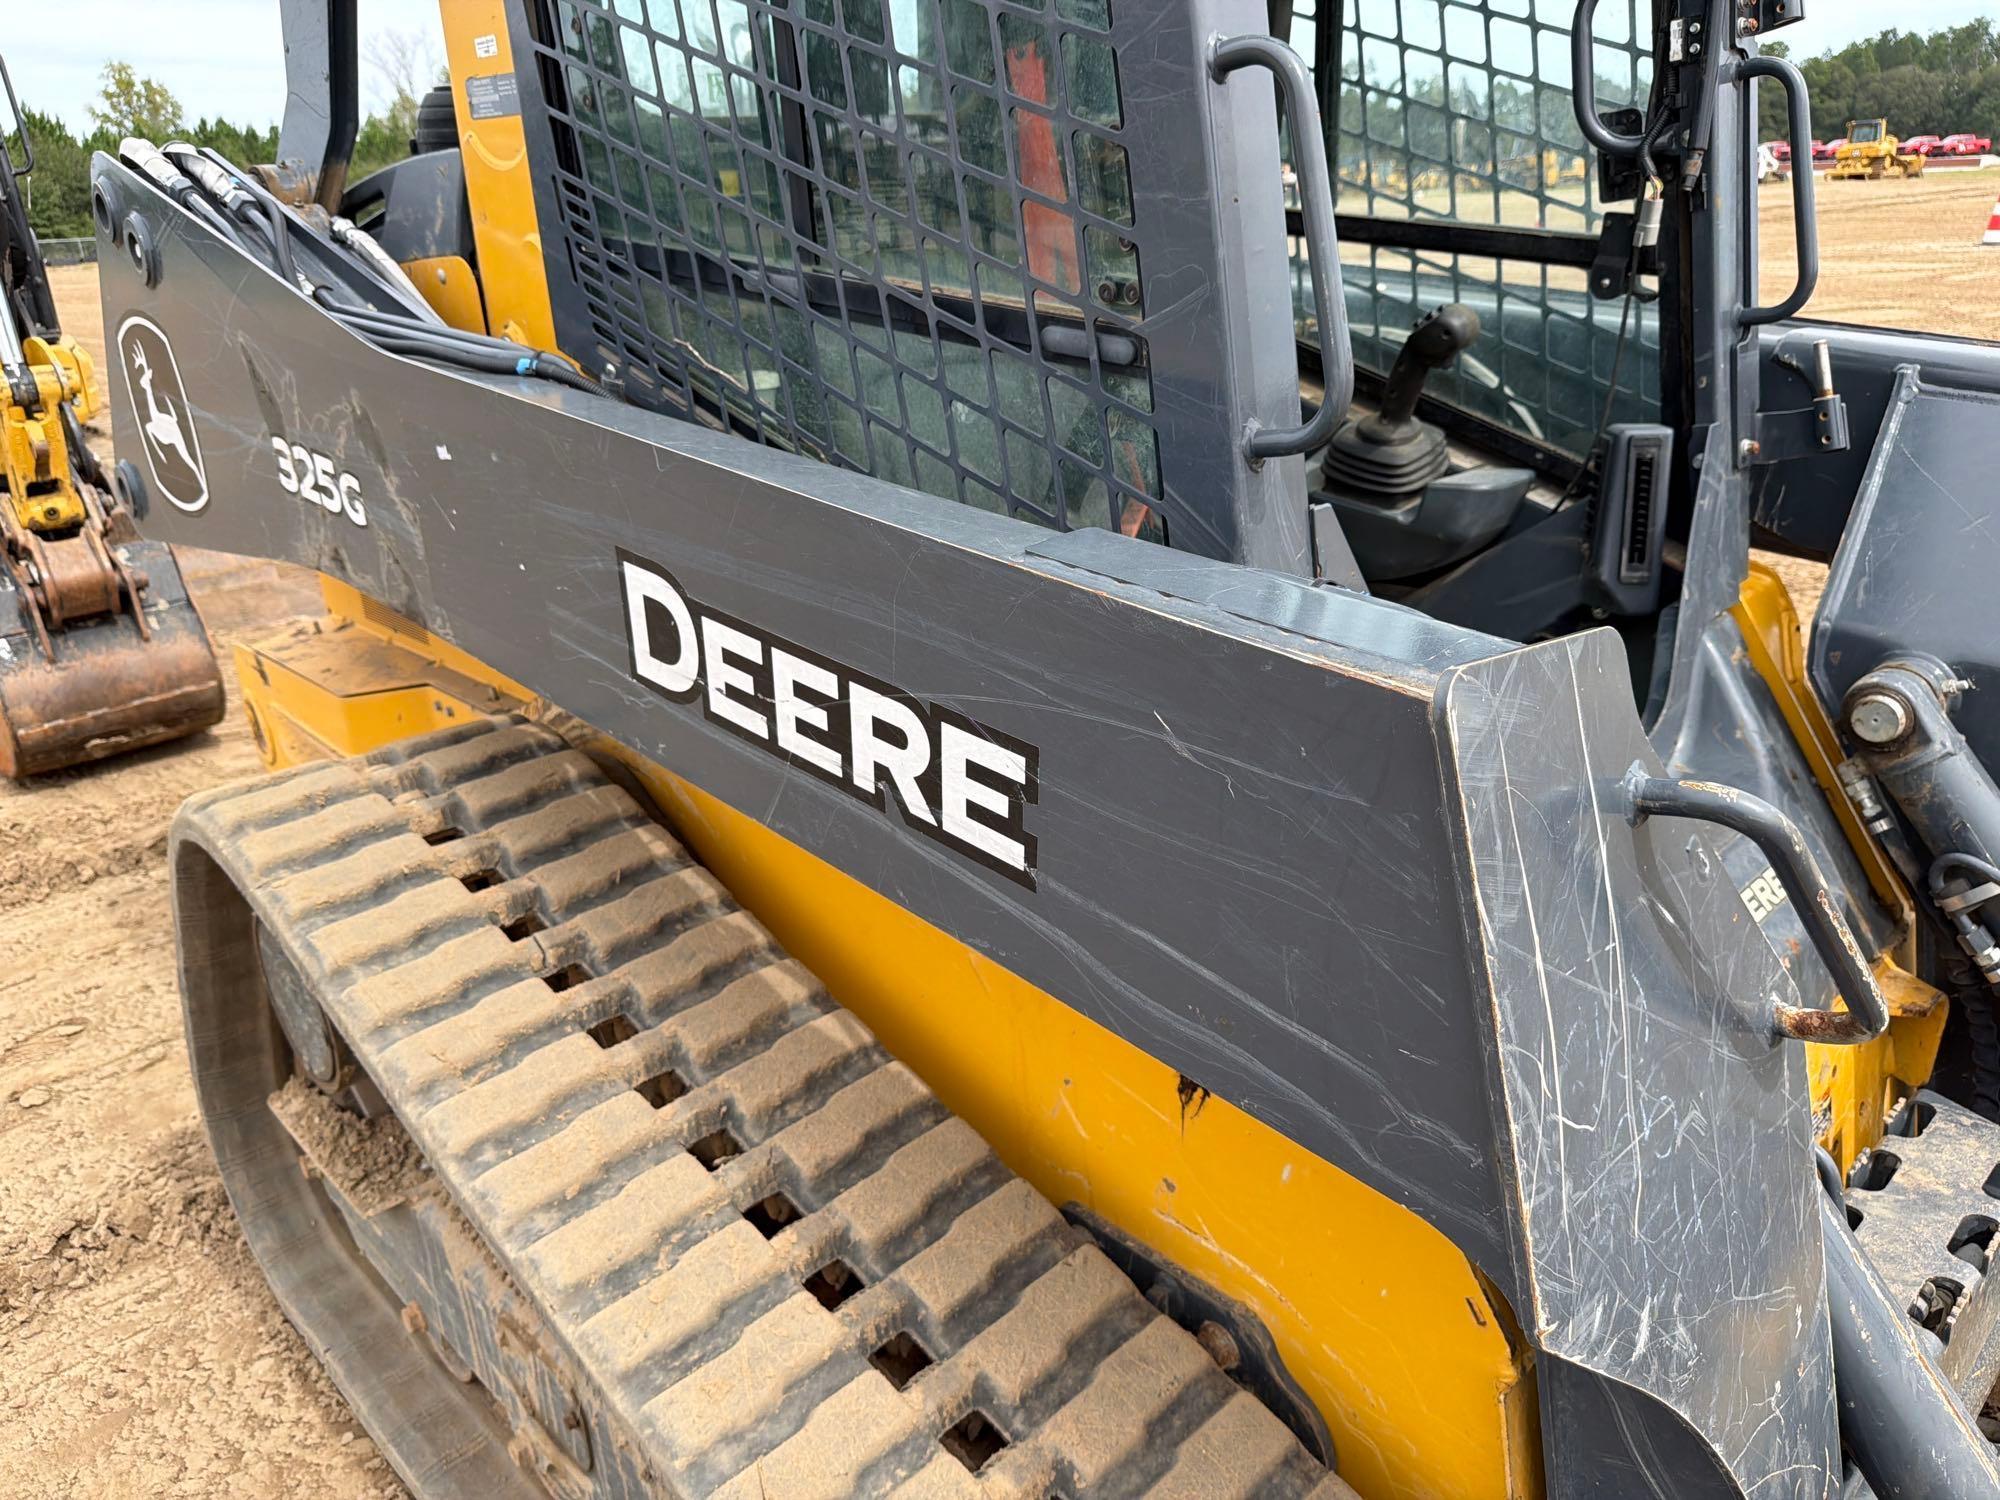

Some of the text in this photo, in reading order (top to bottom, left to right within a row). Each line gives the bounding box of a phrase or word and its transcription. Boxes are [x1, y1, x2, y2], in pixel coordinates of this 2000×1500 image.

[271, 435, 368, 527] 325G
[621, 559, 1028, 873] DEERE
[1739, 866, 1788, 924] ERE
